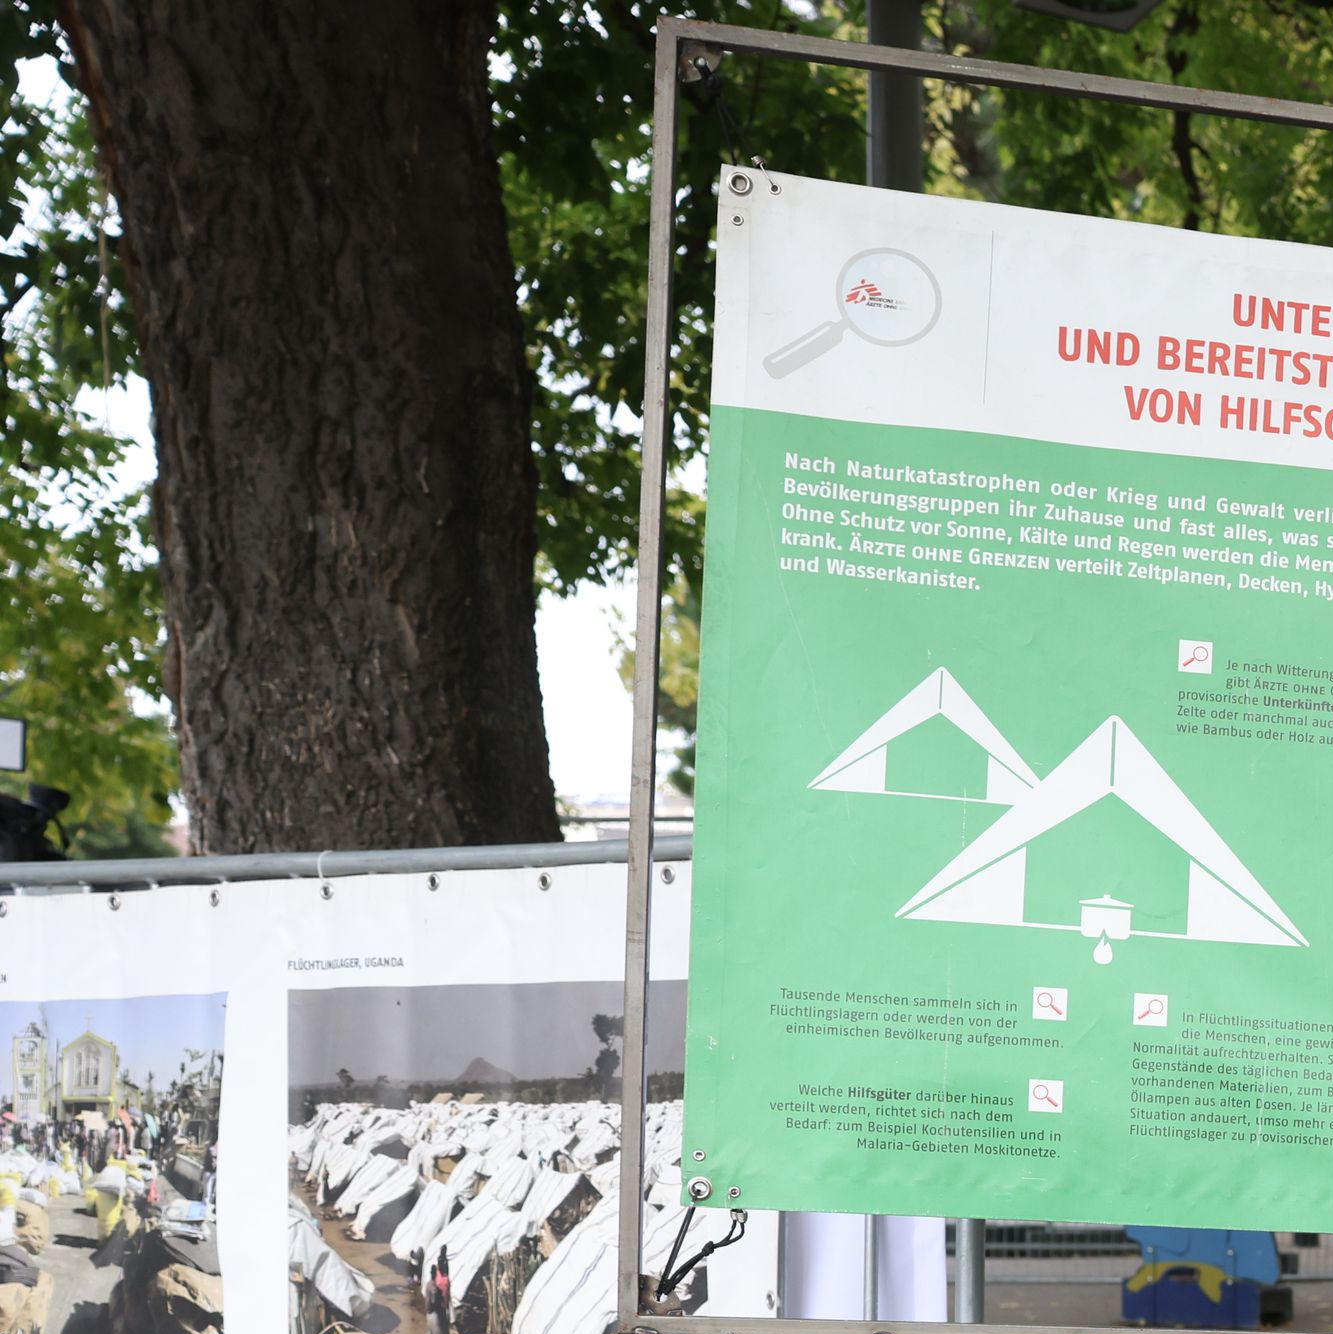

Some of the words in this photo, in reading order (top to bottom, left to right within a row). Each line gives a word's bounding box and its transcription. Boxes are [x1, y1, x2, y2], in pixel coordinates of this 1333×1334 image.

[1058, 326, 1141, 367] UND
[1123, 385, 1202, 425] VON
[785, 452, 836, 474] Nach
[847, 460, 1040, 494] Naturkatastrophen
[1050, 481, 1098, 500] oder
[1107, 486, 1158, 511] Krieg
[1168, 495, 1206, 512] und
[1216, 497, 1285, 520] Gewalt
[783, 477, 1000, 517] Bevölkerungsgruppen
[1009, 499, 1037, 518] ihr
[1044, 503, 1125, 528] Zuhause
[1134, 516, 1171, 533] und
[1179, 518, 1216, 537] fast
[1223, 523, 1273, 546] alles,
[1282, 531, 1319, 547] was
[782, 502, 835, 524] Ohne
[839, 509, 905, 532] Schutz
[910, 521, 942, 536] vor
[946, 520, 1012, 545] Sonne,
[1019, 526, 1068, 547] Kälte
[1074, 534, 1112, 551] und
[1118, 536, 1176, 559] Regen
[1182, 546, 1254, 565] werden
[1260, 551, 1289, 569] die
[780, 556, 819, 573] und
[826, 558, 981, 591] Wasserkanister.
[781, 527, 843, 551] krank.
[1055, 557, 1123, 577] verteilt
[1127, 561, 1232, 591] Zeltplanen,
[1238, 573, 1308, 598] Decken,
[1225, 659, 1239, 671] Je
[1242, 662, 1273, 674] nach
[1225, 675, 1251, 690] gibt
[1178, 690, 1259, 706] provisorische
[1176, 704, 1207, 719] Zelte
[1210, 708, 1240, 721] oder
[1243, 712, 1308, 727] manchmal
[1176, 721, 1199, 734] wie
[1203, 723, 1253, 739] Bambus
[1256, 728, 1285, 741] oder
[1288, 730, 1315, 744] Holz
[780, 987, 841, 1002] Tausende
[845, 991, 909, 1006] Menschen
[913, 997, 972, 1010] sammeln
[975, 998, 1001, 1012] sich
[1005, 1000, 1018, 1013] in
[770, 1004, 879, 1023] Flüchtlingslagern
[883, 1010, 913, 1023] oder
[916, 1013, 964, 1026] werden
[968, 1017, 992, 1028] von
[996, 1017, 1018, 1029] der
[1182, 1011, 1194, 1024] In
[1199, 1012, 1333, 1033] Flüchtlingssituationen
[785, 1022, 880, 1038] einheimischen
[884, 1027, 963, 1046] Bevölkerung
[967, 1032, 1064, 1049] aufgenommen.
[1181, 1027, 1201, 1040] die
[1205, 1029, 1270, 1047] Menschen,
[1274, 1034, 1302, 1047] eine
[1133, 1041, 1200, 1057] Normalität
[1202, 1046, 1323, 1065] aufrechtzuerhalten.
[1132, 1057, 1213, 1074] Gegenstände
[1217, 1063, 1239, 1076] des
[1242, 1064, 1299, 1079] täglichen
[798, 1083, 844, 1098] Welche
[847, 1086, 912, 1103] Hilfsgüter
[915, 1089, 967, 1104] darüber
[970, 1092, 1014, 1107] hinaus
[1131, 1075, 1215, 1091] vorhandenen
[1219, 1079, 1293, 1097] Materialien,
[1297, 1086, 1323, 1097] zum
[769, 1100, 816, 1113] verteilt
[818, 1102, 871, 1118] werden,
[875, 1104, 918, 1118] richtet
[920, 1107, 945, 1119] sich
[950, 1109, 981, 1121] nach
[985, 1110, 1013, 1123] dem
[1130, 1089, 1190, 1107] Öllampen
[1194, 1096, 1216, 1107] aus
[1219, 1096, 1251, 1109] alten
[1255, 1098, 1296, 1112] Dosen.
[1300, 1100, 1313, 1113] Je
[786, 1116, 832, 1131] Bedarf:
[835, 1121, 863, 1132] zum
[867, 1120, 917, 1136] Beispiel
[921, 1123, 1016, 1140] Kochutensilien
[1020, 1129, 1045, 1141] und
[1049, 1130, 1061, 1143] in
[1130, 1107, 1186, 1122] Situation
[1190, 1111, 1251, 1127] andauert,
[1293, 1117, 1326, 1130] mehr
[1129, 1124, 1228, 1143] Flüchtlingslager
[1231, 1131, 1245, 1141] zu
[856, 1137, 969, 1154] Malaria-Gebieten
[973, 1143, 1061, 1159] Moskitonetze.
